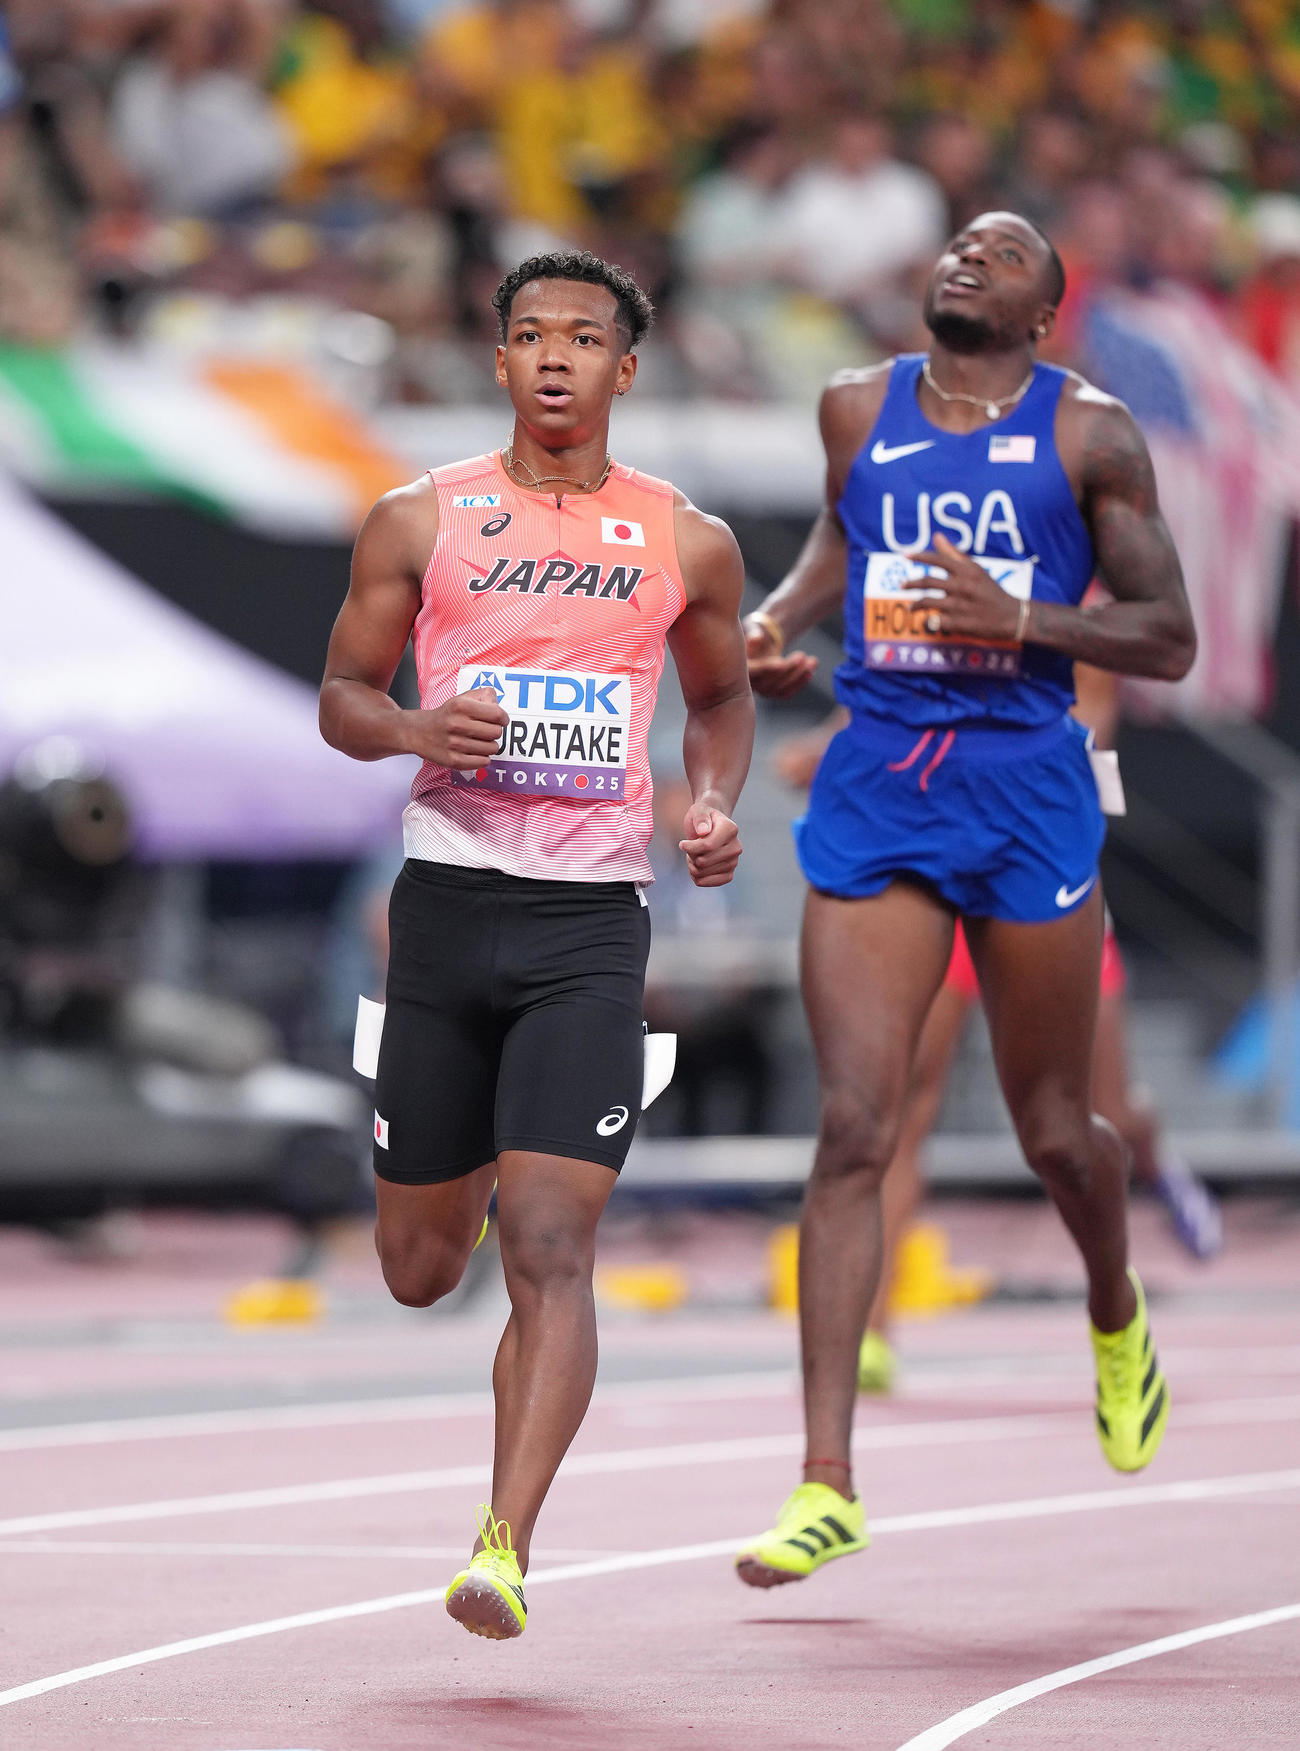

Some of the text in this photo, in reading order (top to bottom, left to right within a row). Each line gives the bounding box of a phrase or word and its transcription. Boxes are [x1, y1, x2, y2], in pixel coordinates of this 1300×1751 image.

[455, 495, 498, 507] ACN
[882, 489, 1025, 555] USA
[468, 558, 644, 602] JAPAN
[504, 673, 622, 715] TDK
